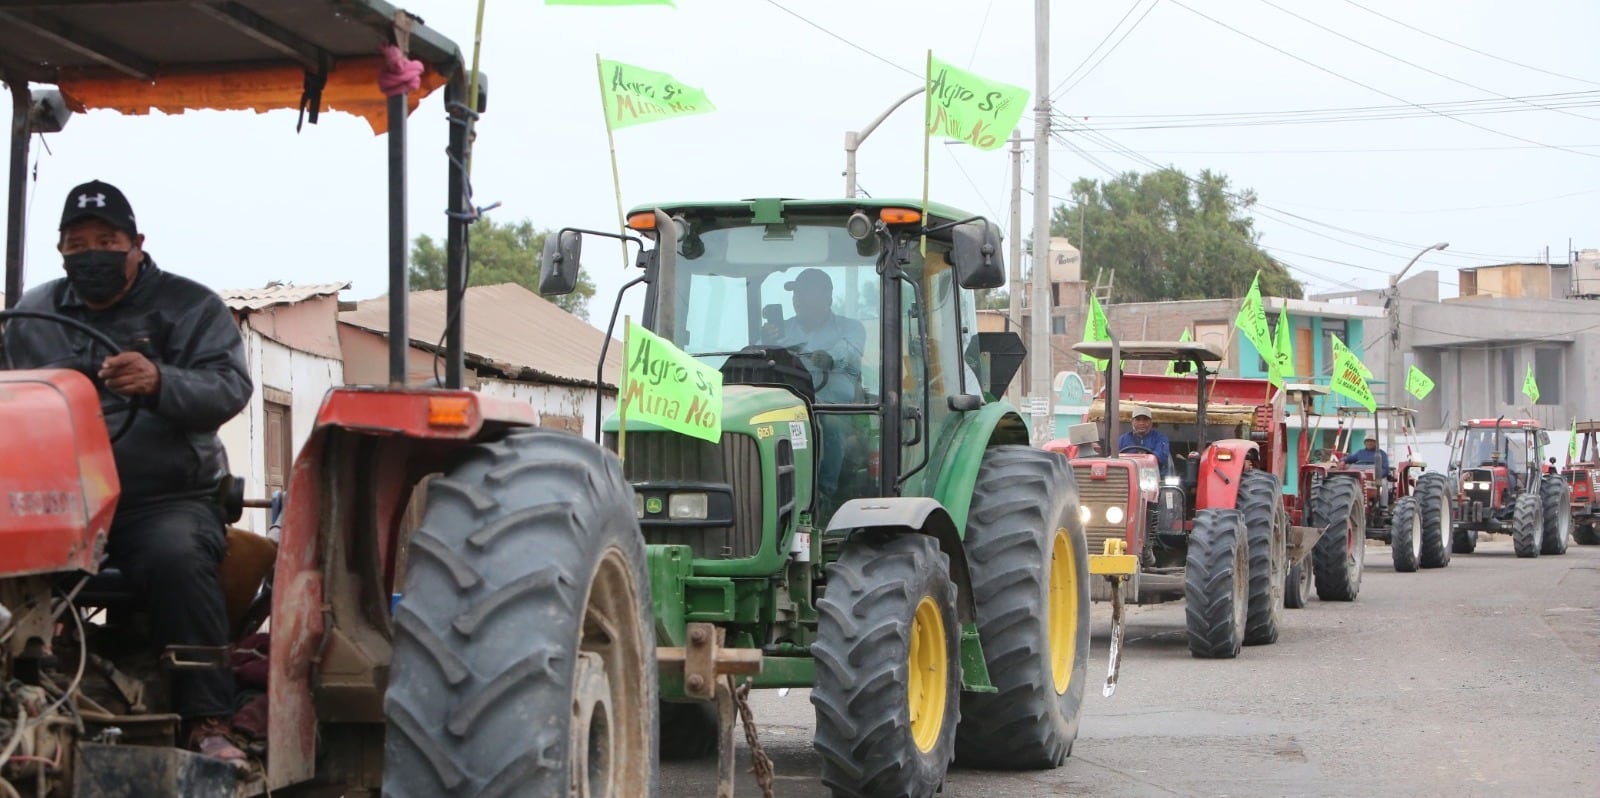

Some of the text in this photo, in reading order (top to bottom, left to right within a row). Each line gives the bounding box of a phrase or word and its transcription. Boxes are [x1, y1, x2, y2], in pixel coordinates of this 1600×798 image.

[612, 65, 655, 98] Agro
[931, 69, 974, 108] Agro
[963, 119, 996, 147] No
[630, 338, 687, 385] Agro
[1343, 369, 1362, 386] MINA
[625, 378, 716, 428] Mina No
